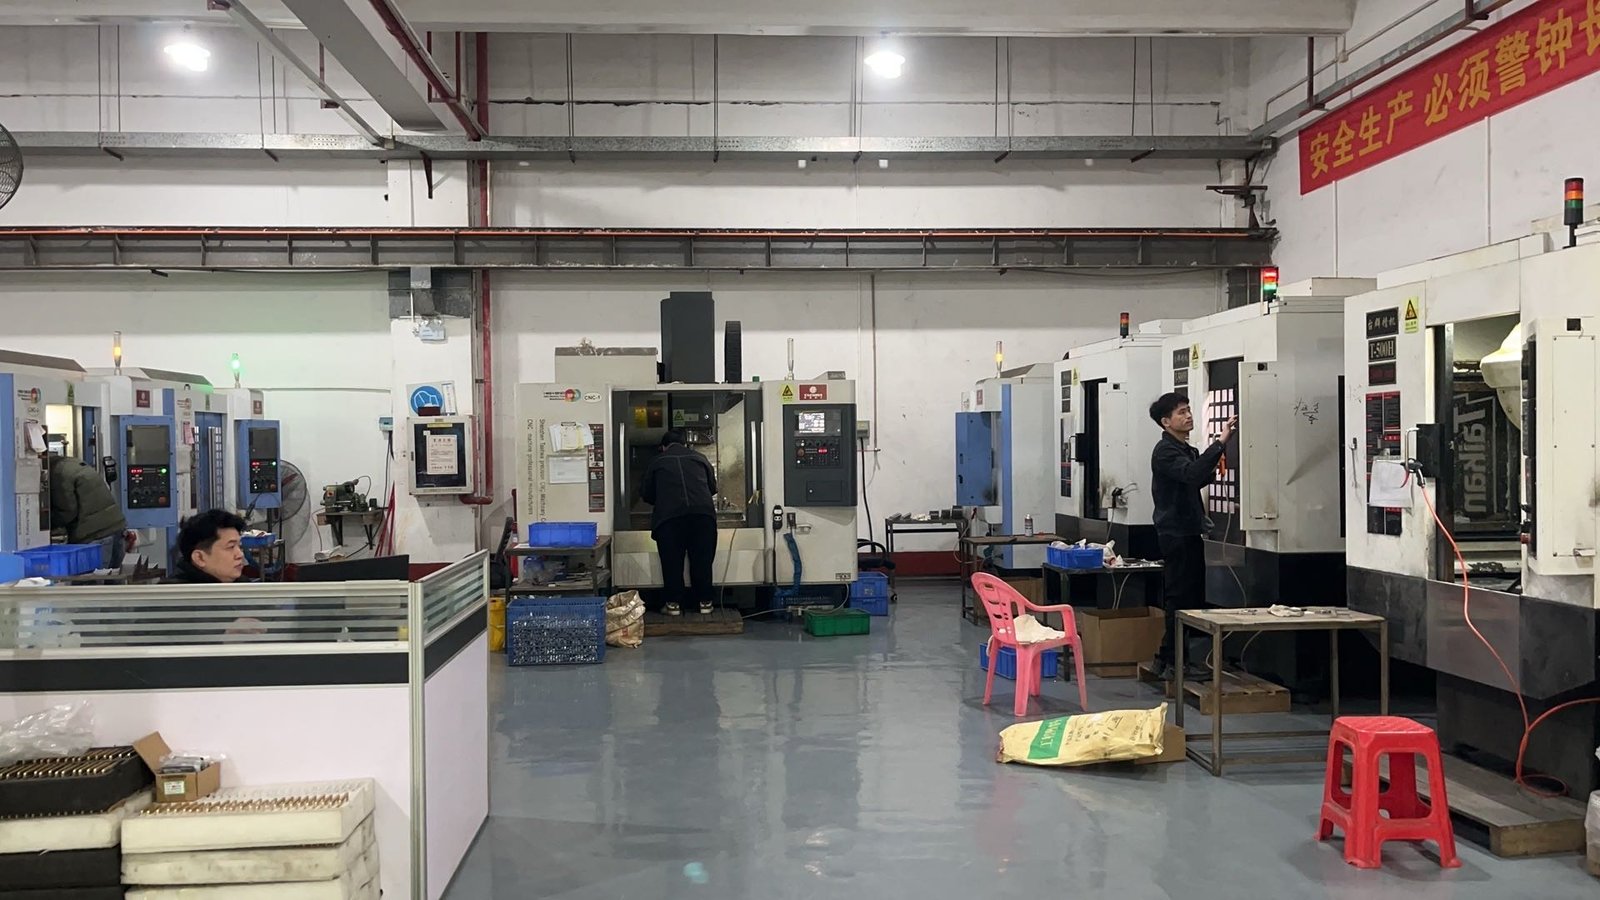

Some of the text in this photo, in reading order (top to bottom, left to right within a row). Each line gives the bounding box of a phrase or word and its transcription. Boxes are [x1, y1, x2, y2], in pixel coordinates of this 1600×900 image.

[1310, 89, 1414, 180] 安全生产
[1370, 340, 1394, 359] T-500H
